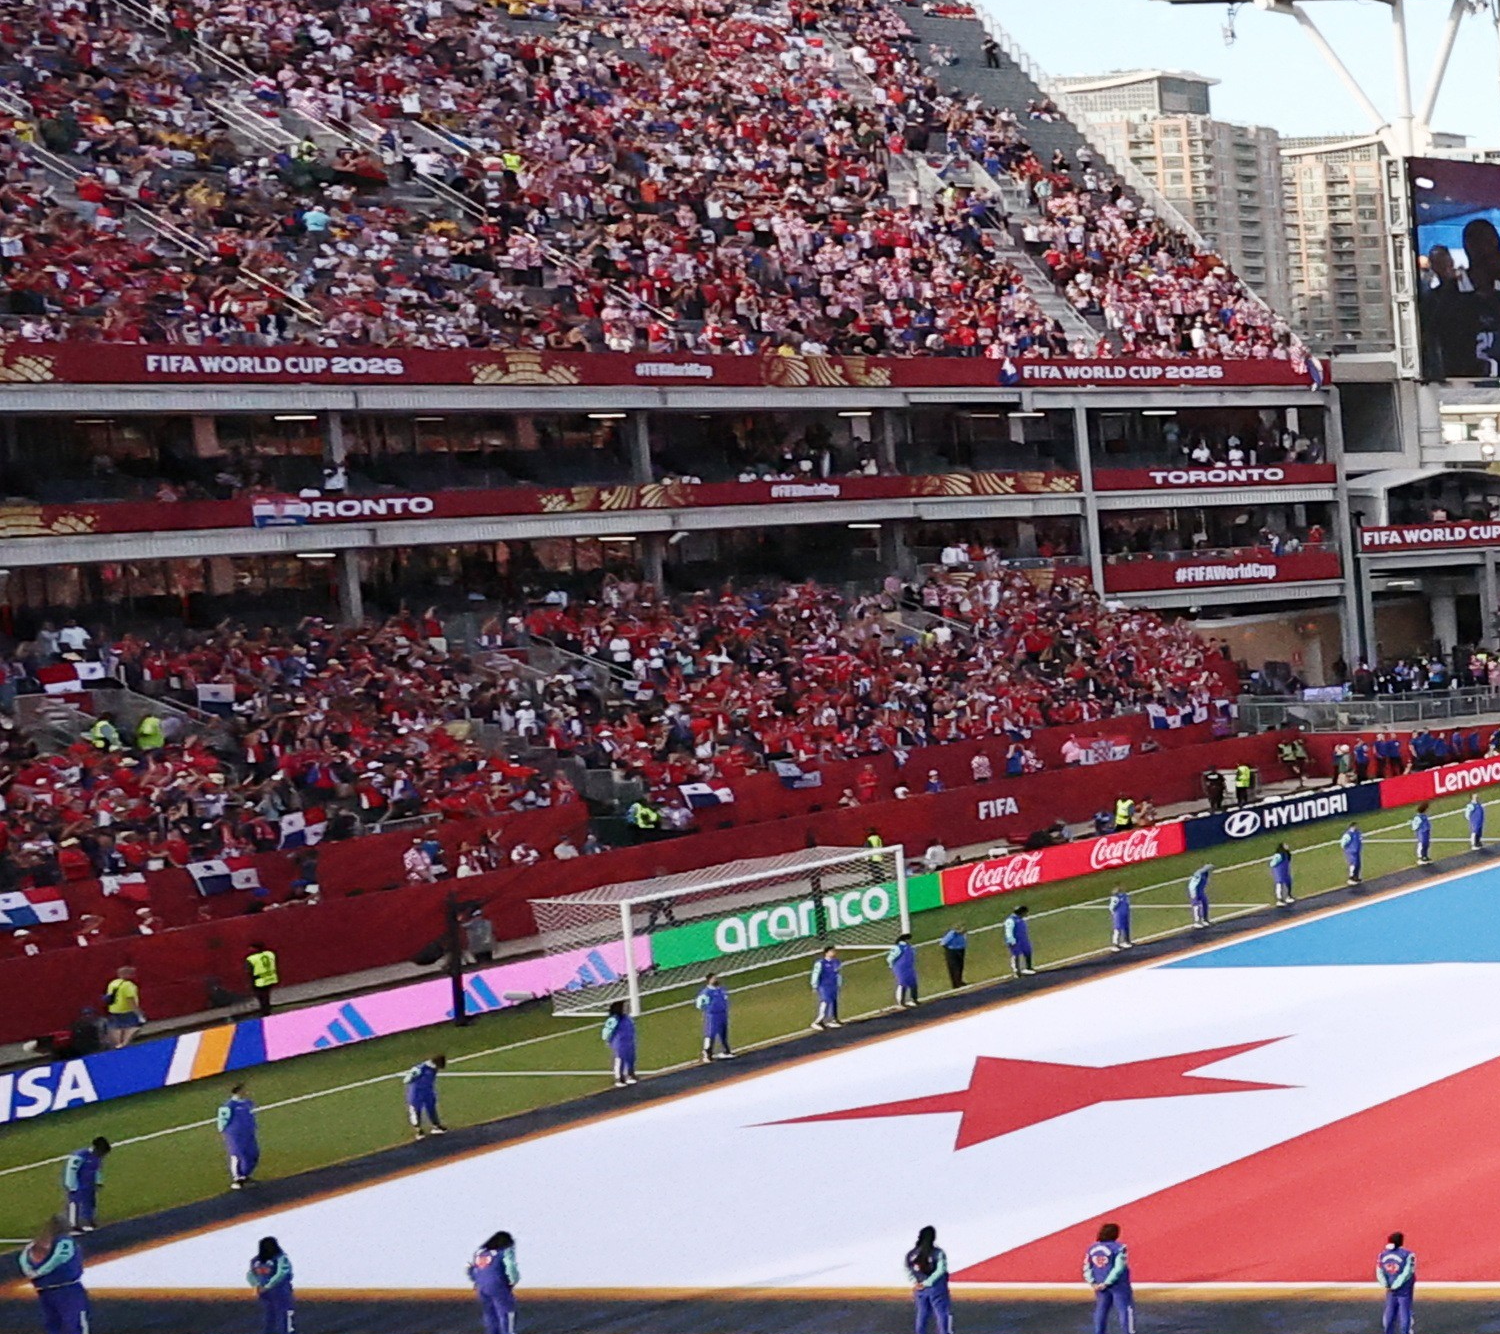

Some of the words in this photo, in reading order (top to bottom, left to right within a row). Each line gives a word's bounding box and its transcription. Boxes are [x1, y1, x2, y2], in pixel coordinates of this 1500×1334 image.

[146, 353, 198, 372] FIFA
[199, 354, 282, 374] WORLD
[284, 355, 328, 374] CUP
[330, 357, 404, 375] 2026
[1022, 365, 1062, 381] FIFA
[1063, 366, 1126, 381] WORLD
[1128, 366, 1162, 381] CUP
[1164, 365, 1223, 380] 2026
[1149, 467, 1285, 485] TORONTO
[300, 496, 434, 519] ORONTO
[1363, 529, 1401, 547] FIFA
[1401, 526, 1467, 545] WORLD
[1175, 562, 1277, 584] #FIFAWorldCup
[978, 797, 1018, 821] FIFA
[1263, 790, 1348, 827] HYUNDAI
[714, 886, 889, 952] aramco
